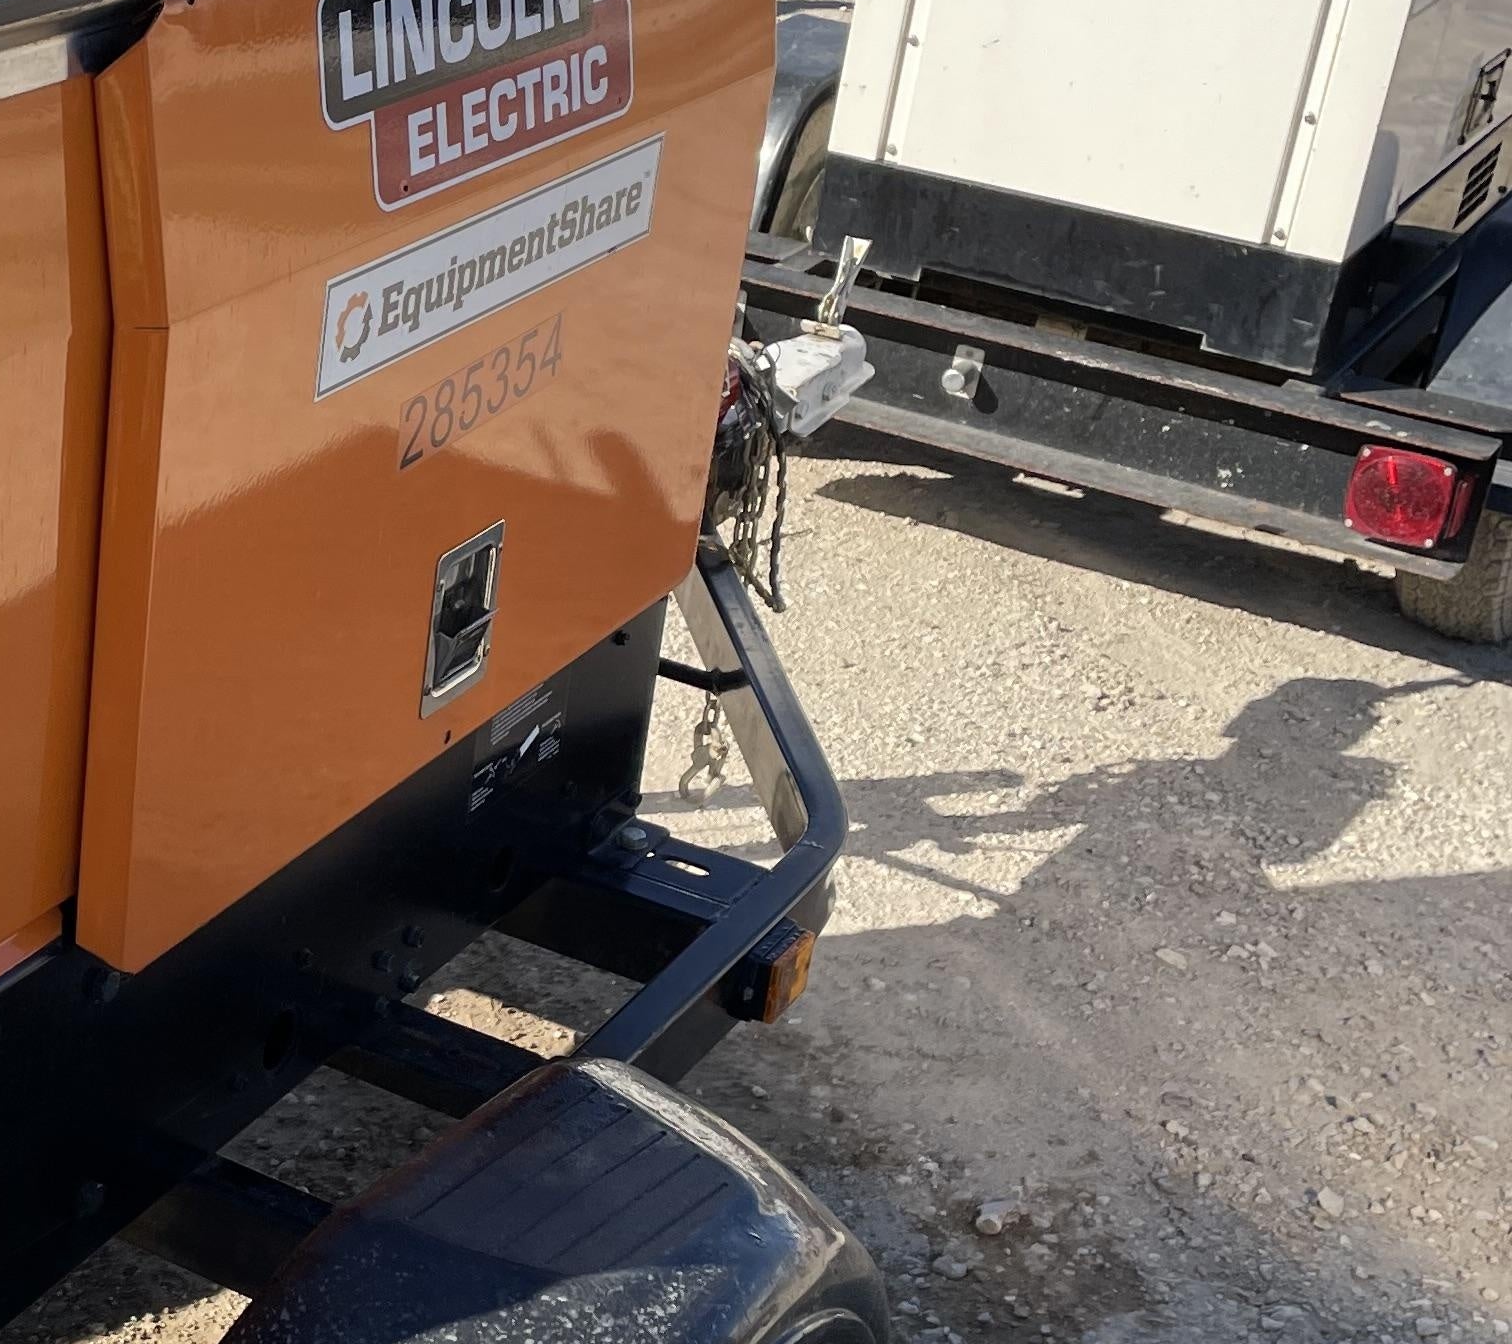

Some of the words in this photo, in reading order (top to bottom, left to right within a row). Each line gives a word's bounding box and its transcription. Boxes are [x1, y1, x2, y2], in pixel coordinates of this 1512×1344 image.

[407, 43, 609, 177] ELECTRIC
[378, 179, 645, 337] EquipmentShare
[399, 312, 563, 470] 285354
